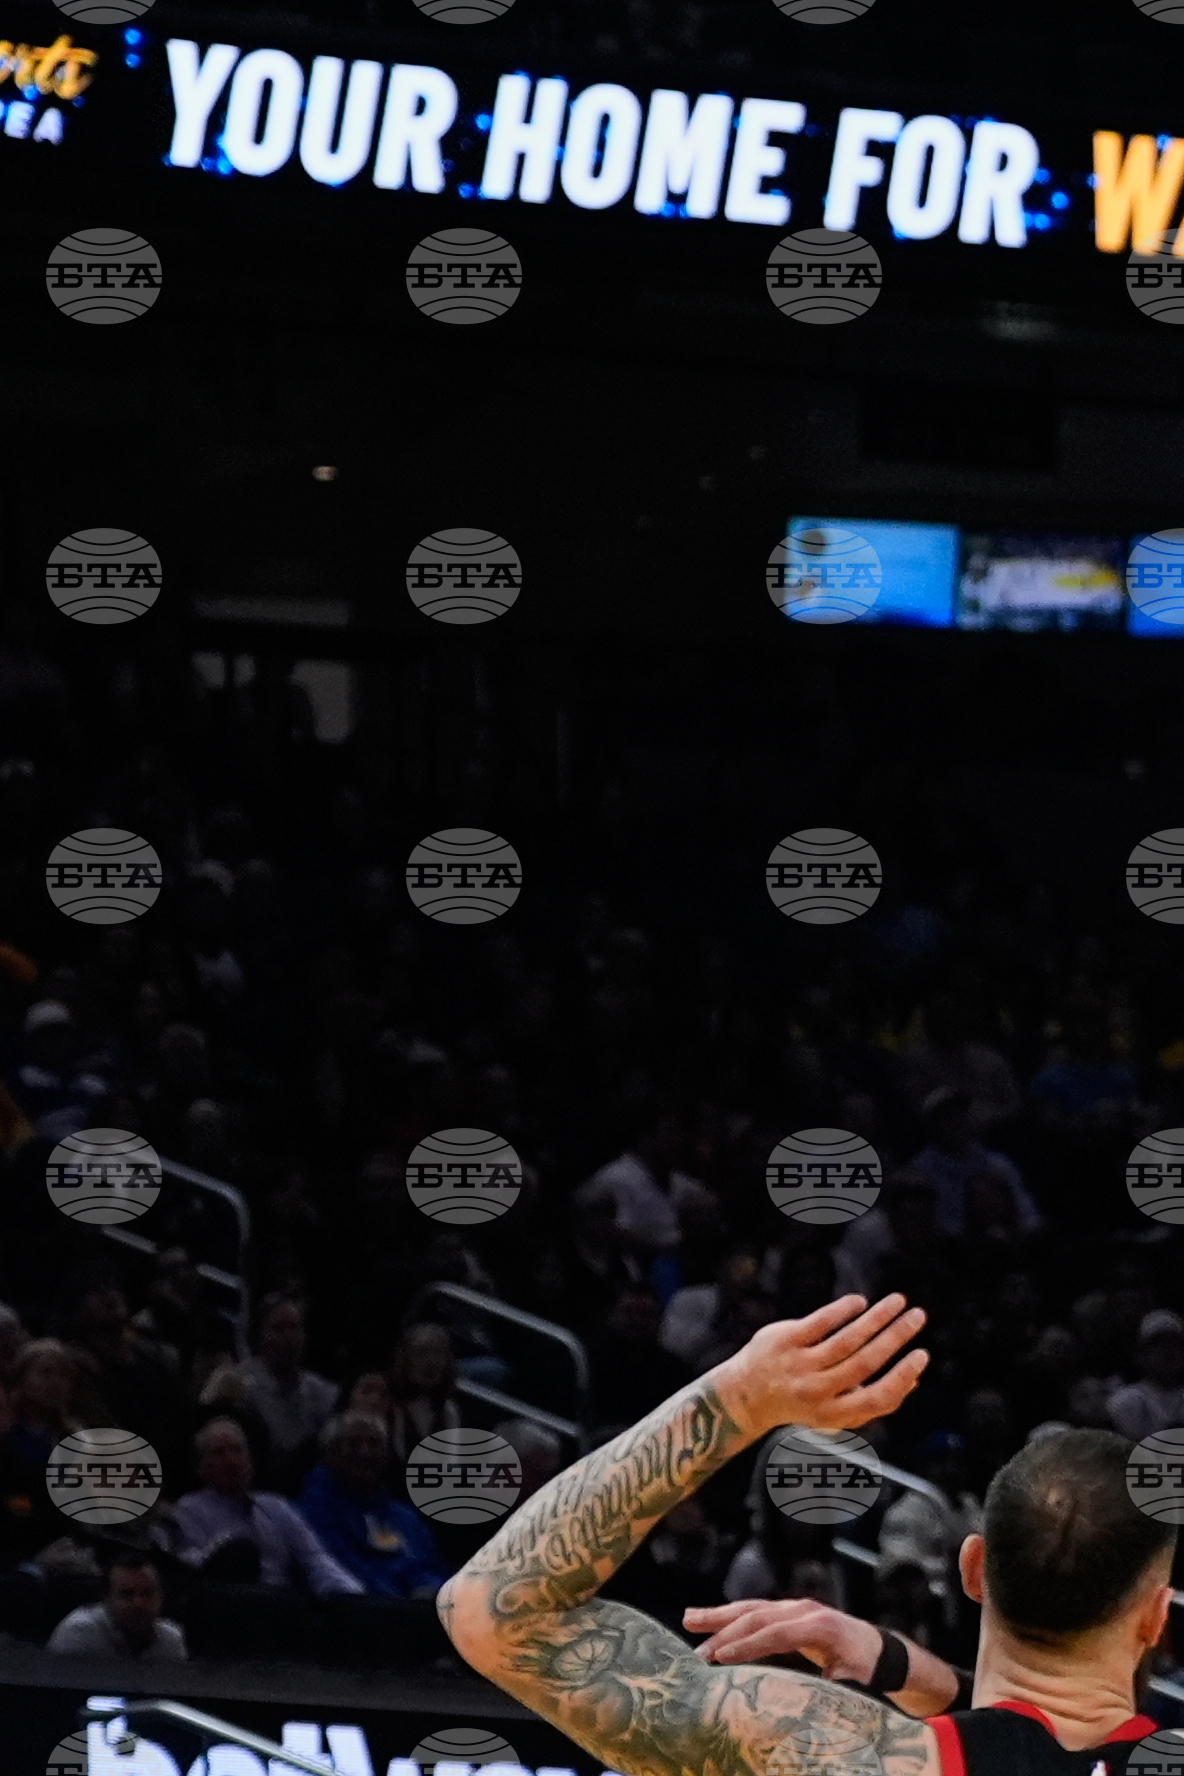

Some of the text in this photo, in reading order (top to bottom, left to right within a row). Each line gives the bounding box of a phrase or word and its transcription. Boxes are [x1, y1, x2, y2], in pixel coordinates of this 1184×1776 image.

[166, 38, 458, 194] YOUR
[480, 74, 806, 226] HOME
[823, 107, 1039, 248] FOR
